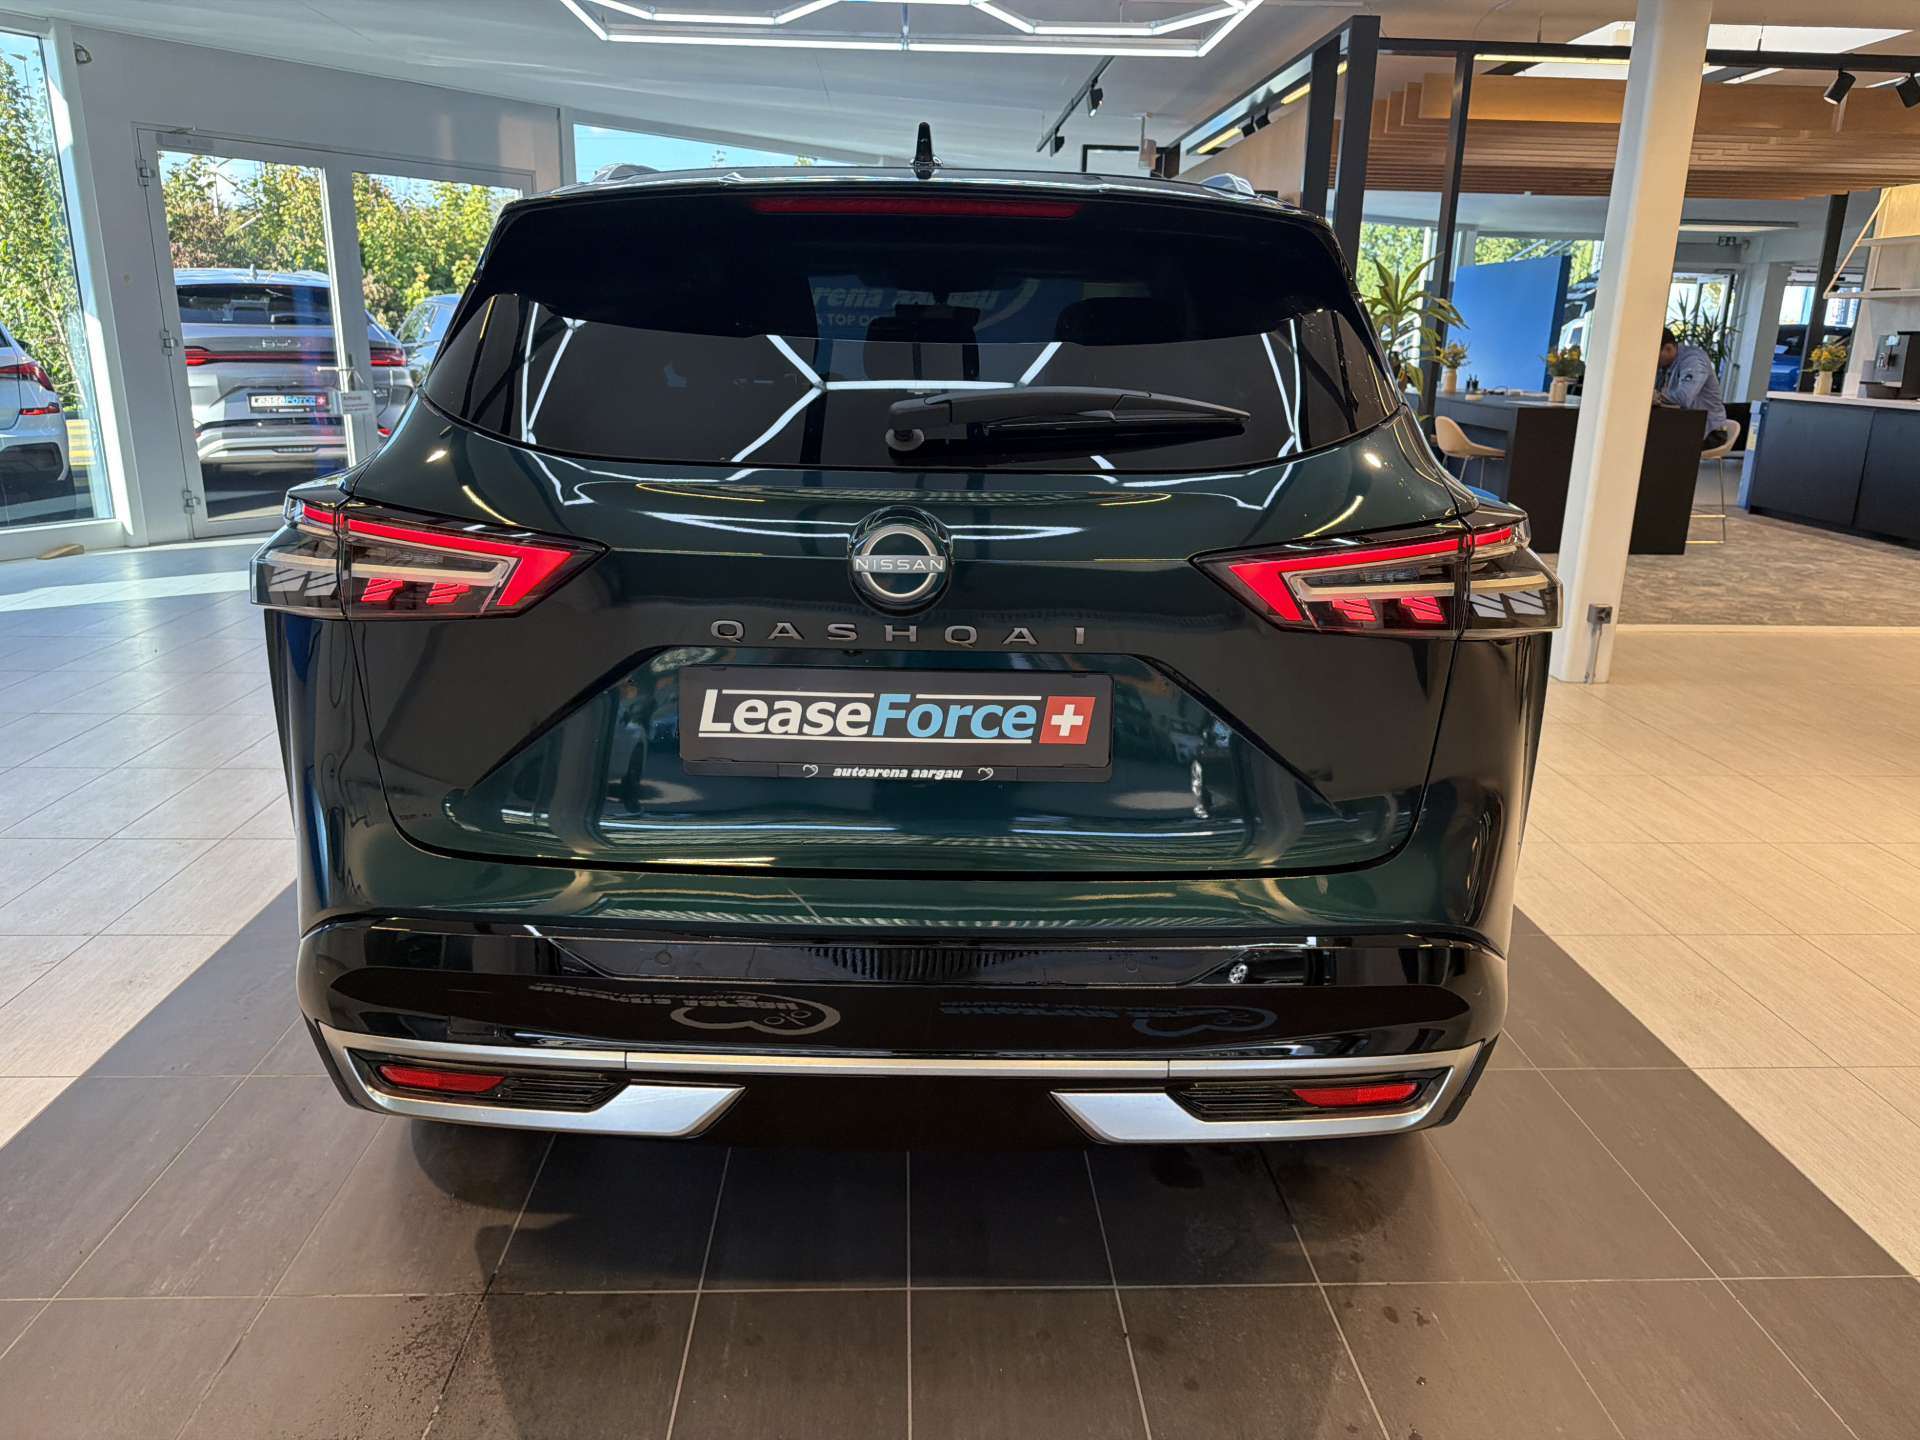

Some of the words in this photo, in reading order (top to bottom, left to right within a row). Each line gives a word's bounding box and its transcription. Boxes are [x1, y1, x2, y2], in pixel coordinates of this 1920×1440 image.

[855, 558, 944, 570] NISSAN
[709, 619, 1085, 648] QASHQAI
[698, 688, 1037, 739] LeaseForce
[832, 766, 908, 778] autoarena
[911, 768, 964, 780] aargau
